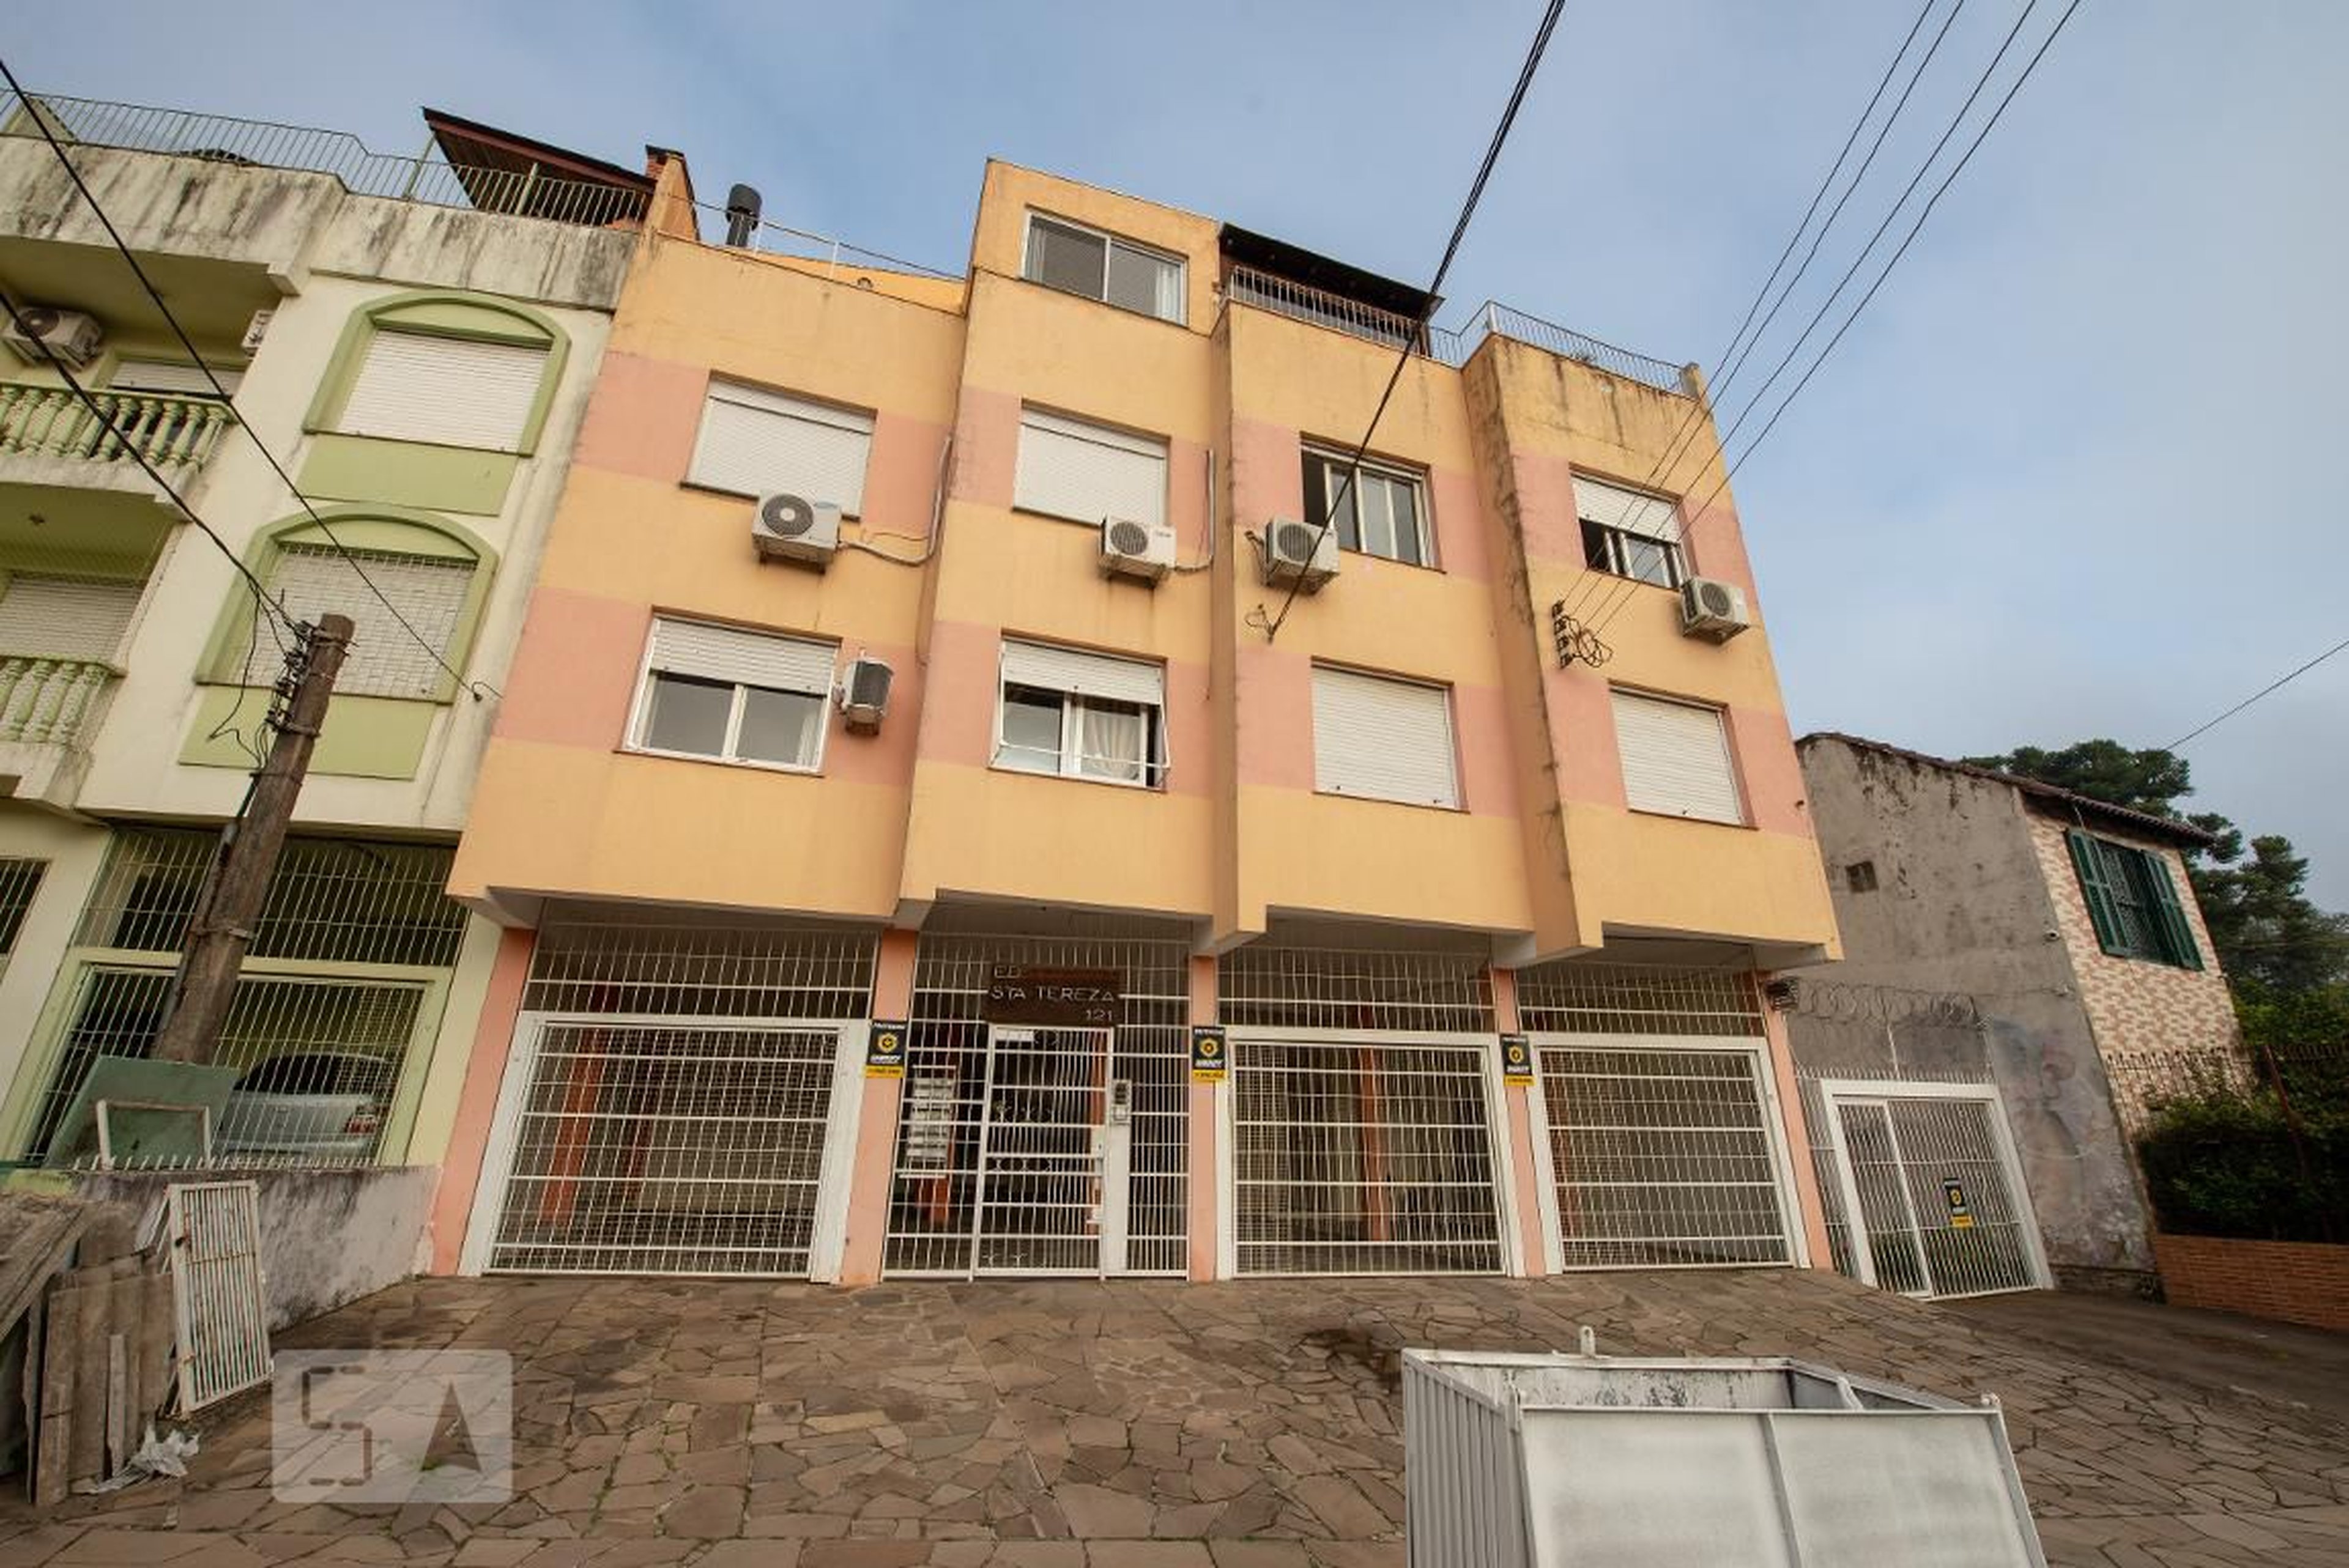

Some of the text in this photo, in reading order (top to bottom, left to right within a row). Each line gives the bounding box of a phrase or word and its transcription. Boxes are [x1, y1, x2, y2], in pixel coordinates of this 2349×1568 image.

[991, 985, 1115, 1002] STA TEREZA
[1086, 1010, 1113, 1022] 121
